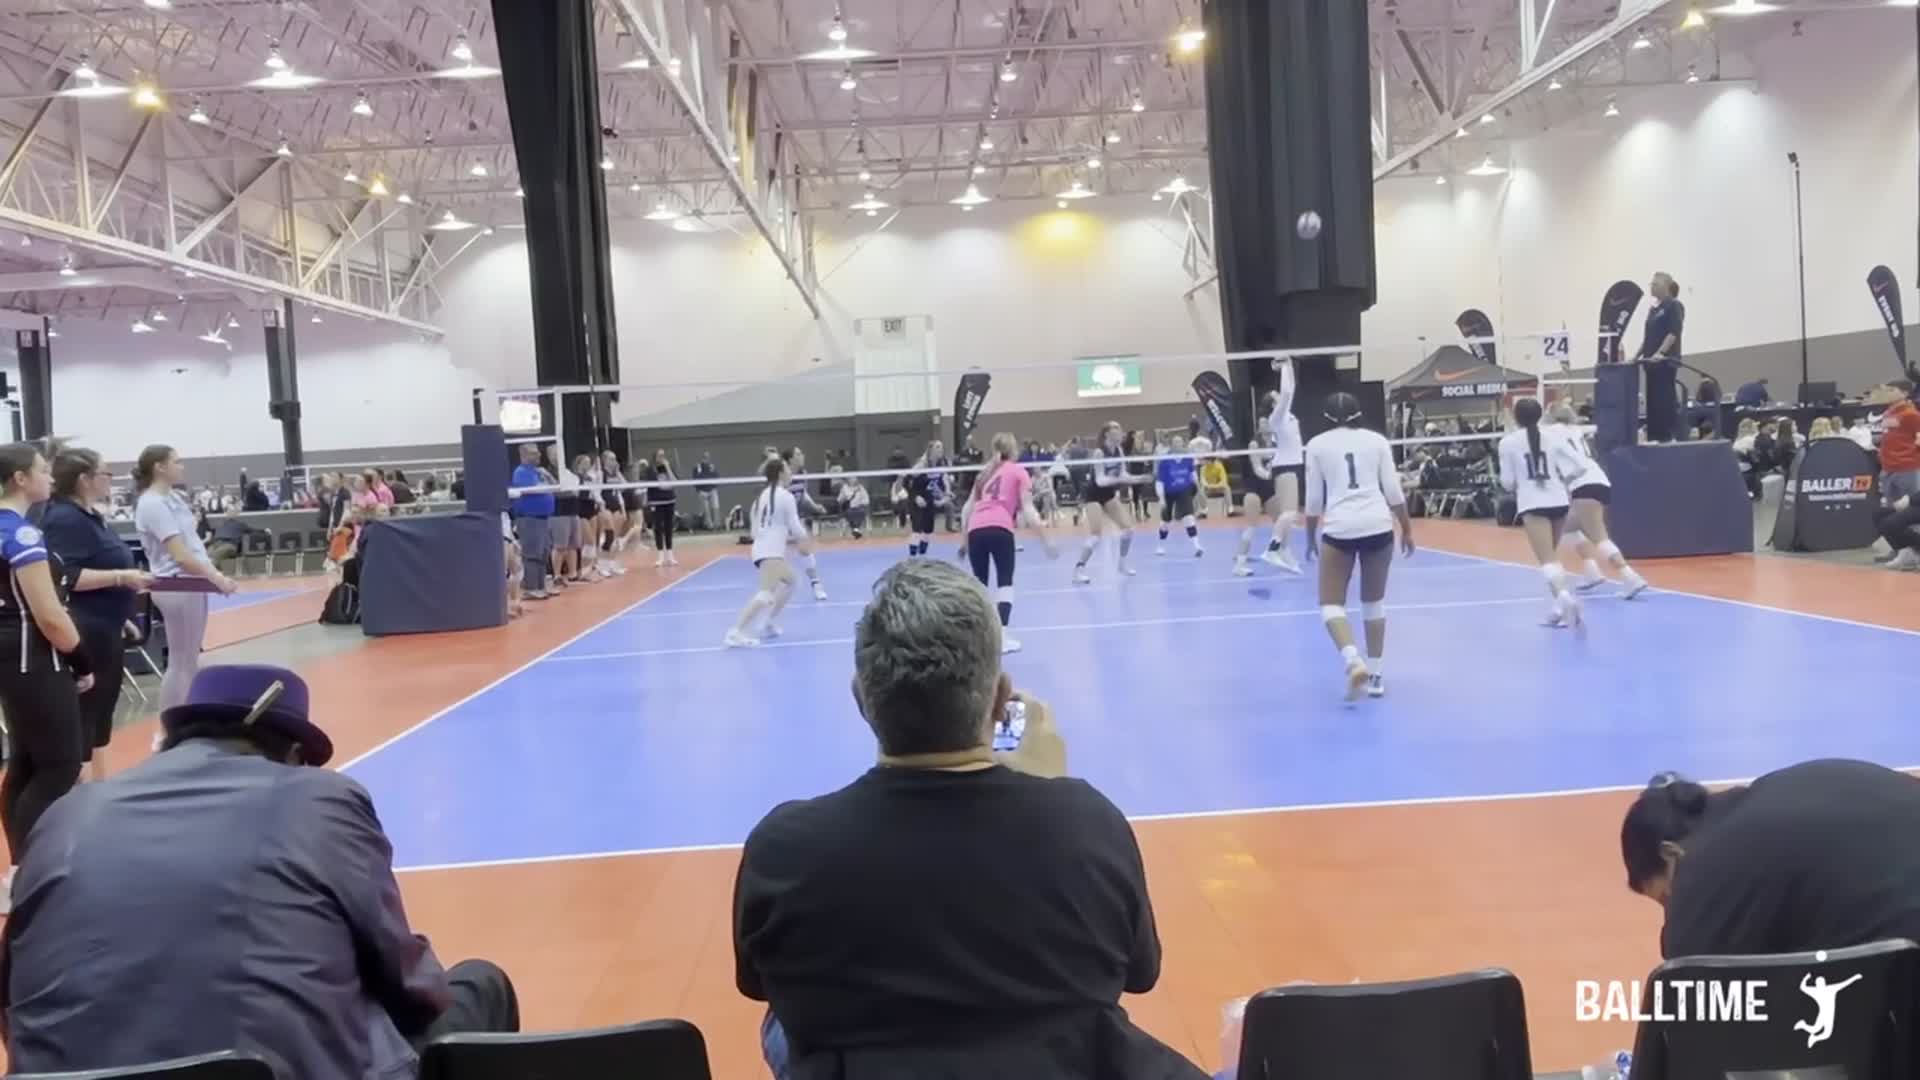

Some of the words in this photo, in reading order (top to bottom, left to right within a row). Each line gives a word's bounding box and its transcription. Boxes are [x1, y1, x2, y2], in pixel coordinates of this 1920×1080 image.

[884, 319, 902, 333] EXIT
[1543, 336, 1569, 356] 24
[1442, 384, 1475, 397] SOCIAL
[1477, 382, 1508, 395] MEDIA
[1344, 452, 1360, 490] 1
[1523, 448, 1551, 481] 10
[1801, 477, 1852, 493] BALLER
